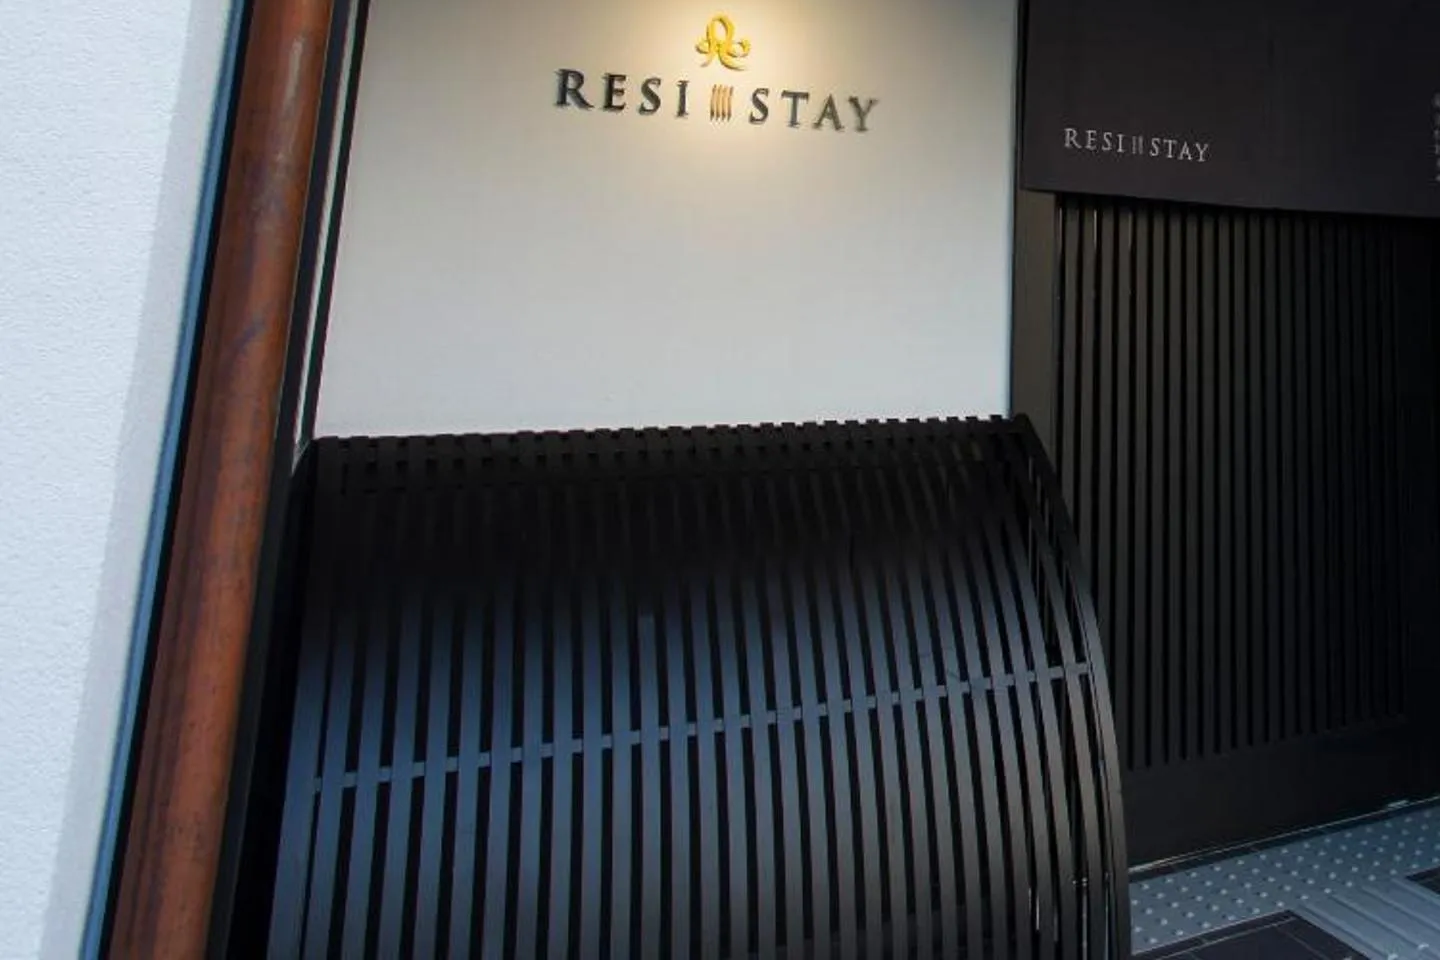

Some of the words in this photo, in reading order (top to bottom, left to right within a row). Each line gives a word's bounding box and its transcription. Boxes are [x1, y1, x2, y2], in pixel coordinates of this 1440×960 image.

[553, 68, 690, 118] RESI
[748, 87, 879, 132] STAY
[1063, 127, 1126, 153] RESI
[1149, 137, 1209, 162] STAY
